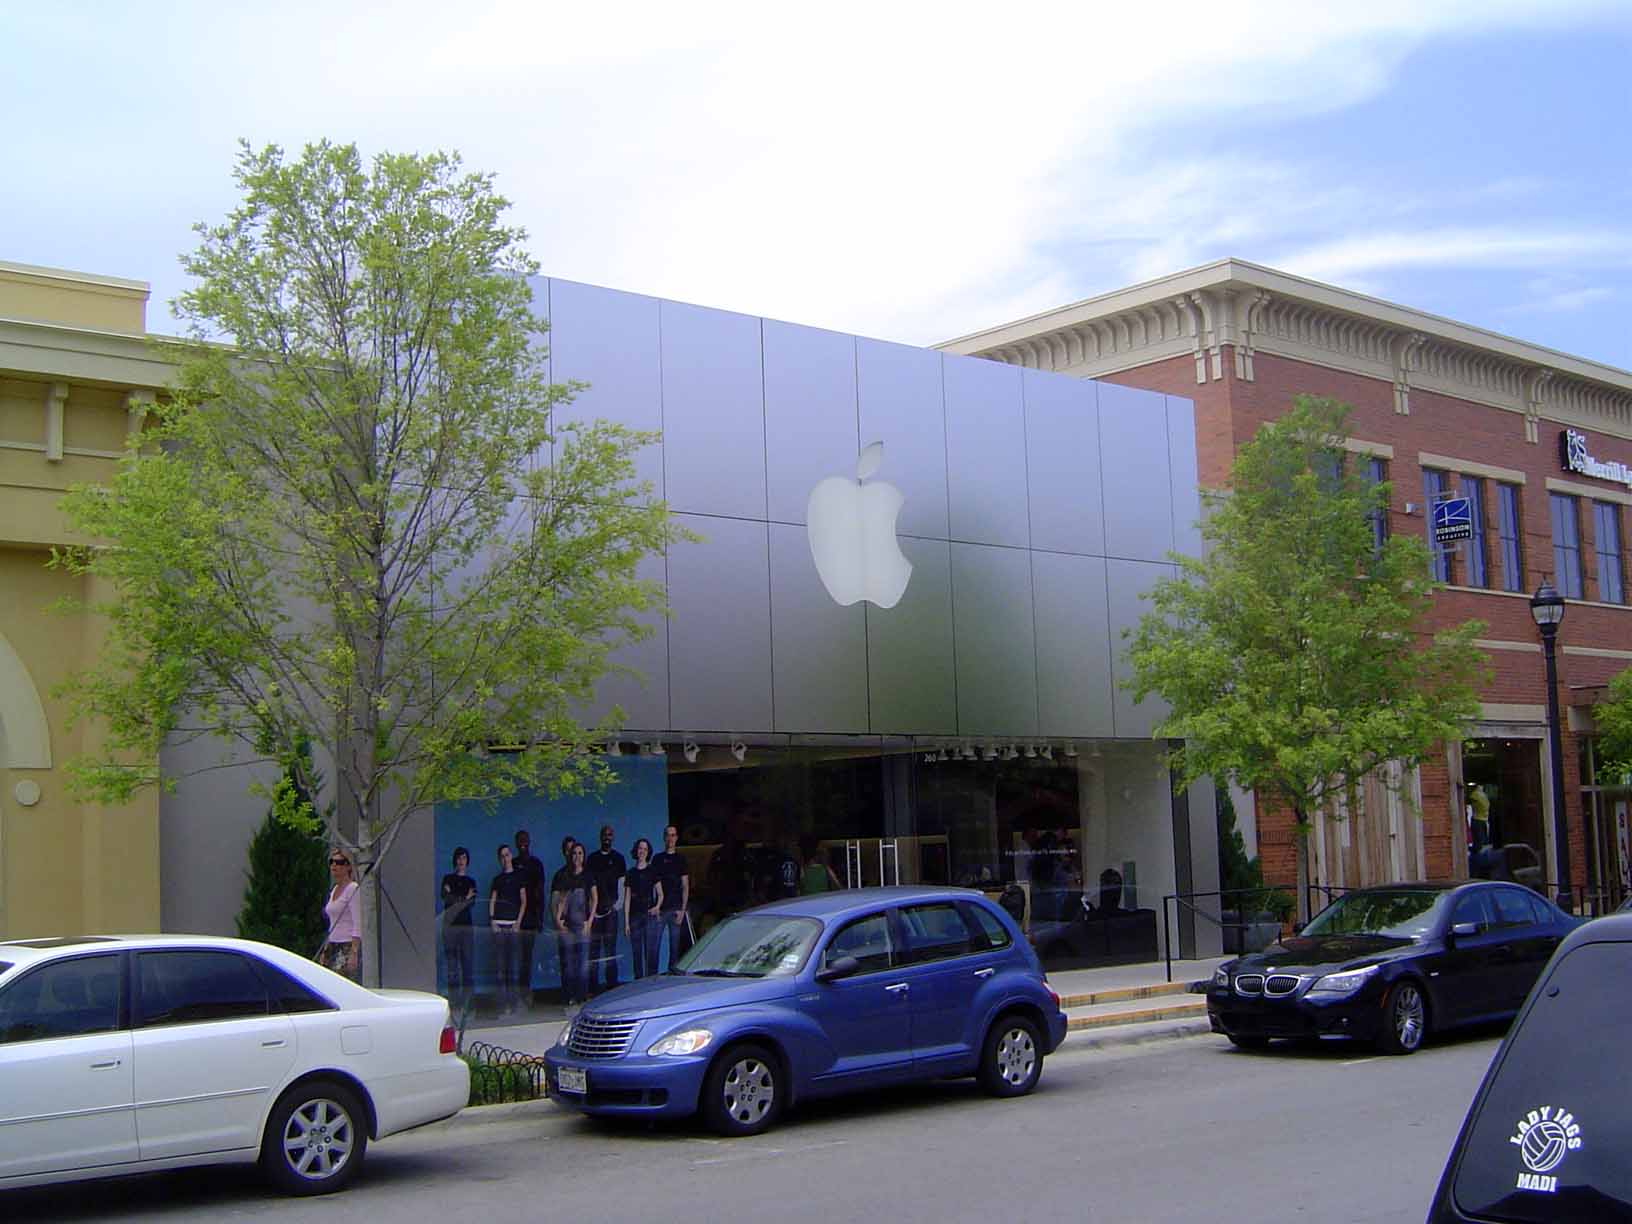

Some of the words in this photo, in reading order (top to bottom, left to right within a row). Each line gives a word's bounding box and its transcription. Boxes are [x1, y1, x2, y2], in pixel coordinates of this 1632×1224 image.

[1436, 525, 1469, 534] ROBINSON
[1510, 1106, 1551, 1145] LADY
[1553, 1108, 1582, 1149] JAGS
[1517, 1173, 1557, 1192] MADI
